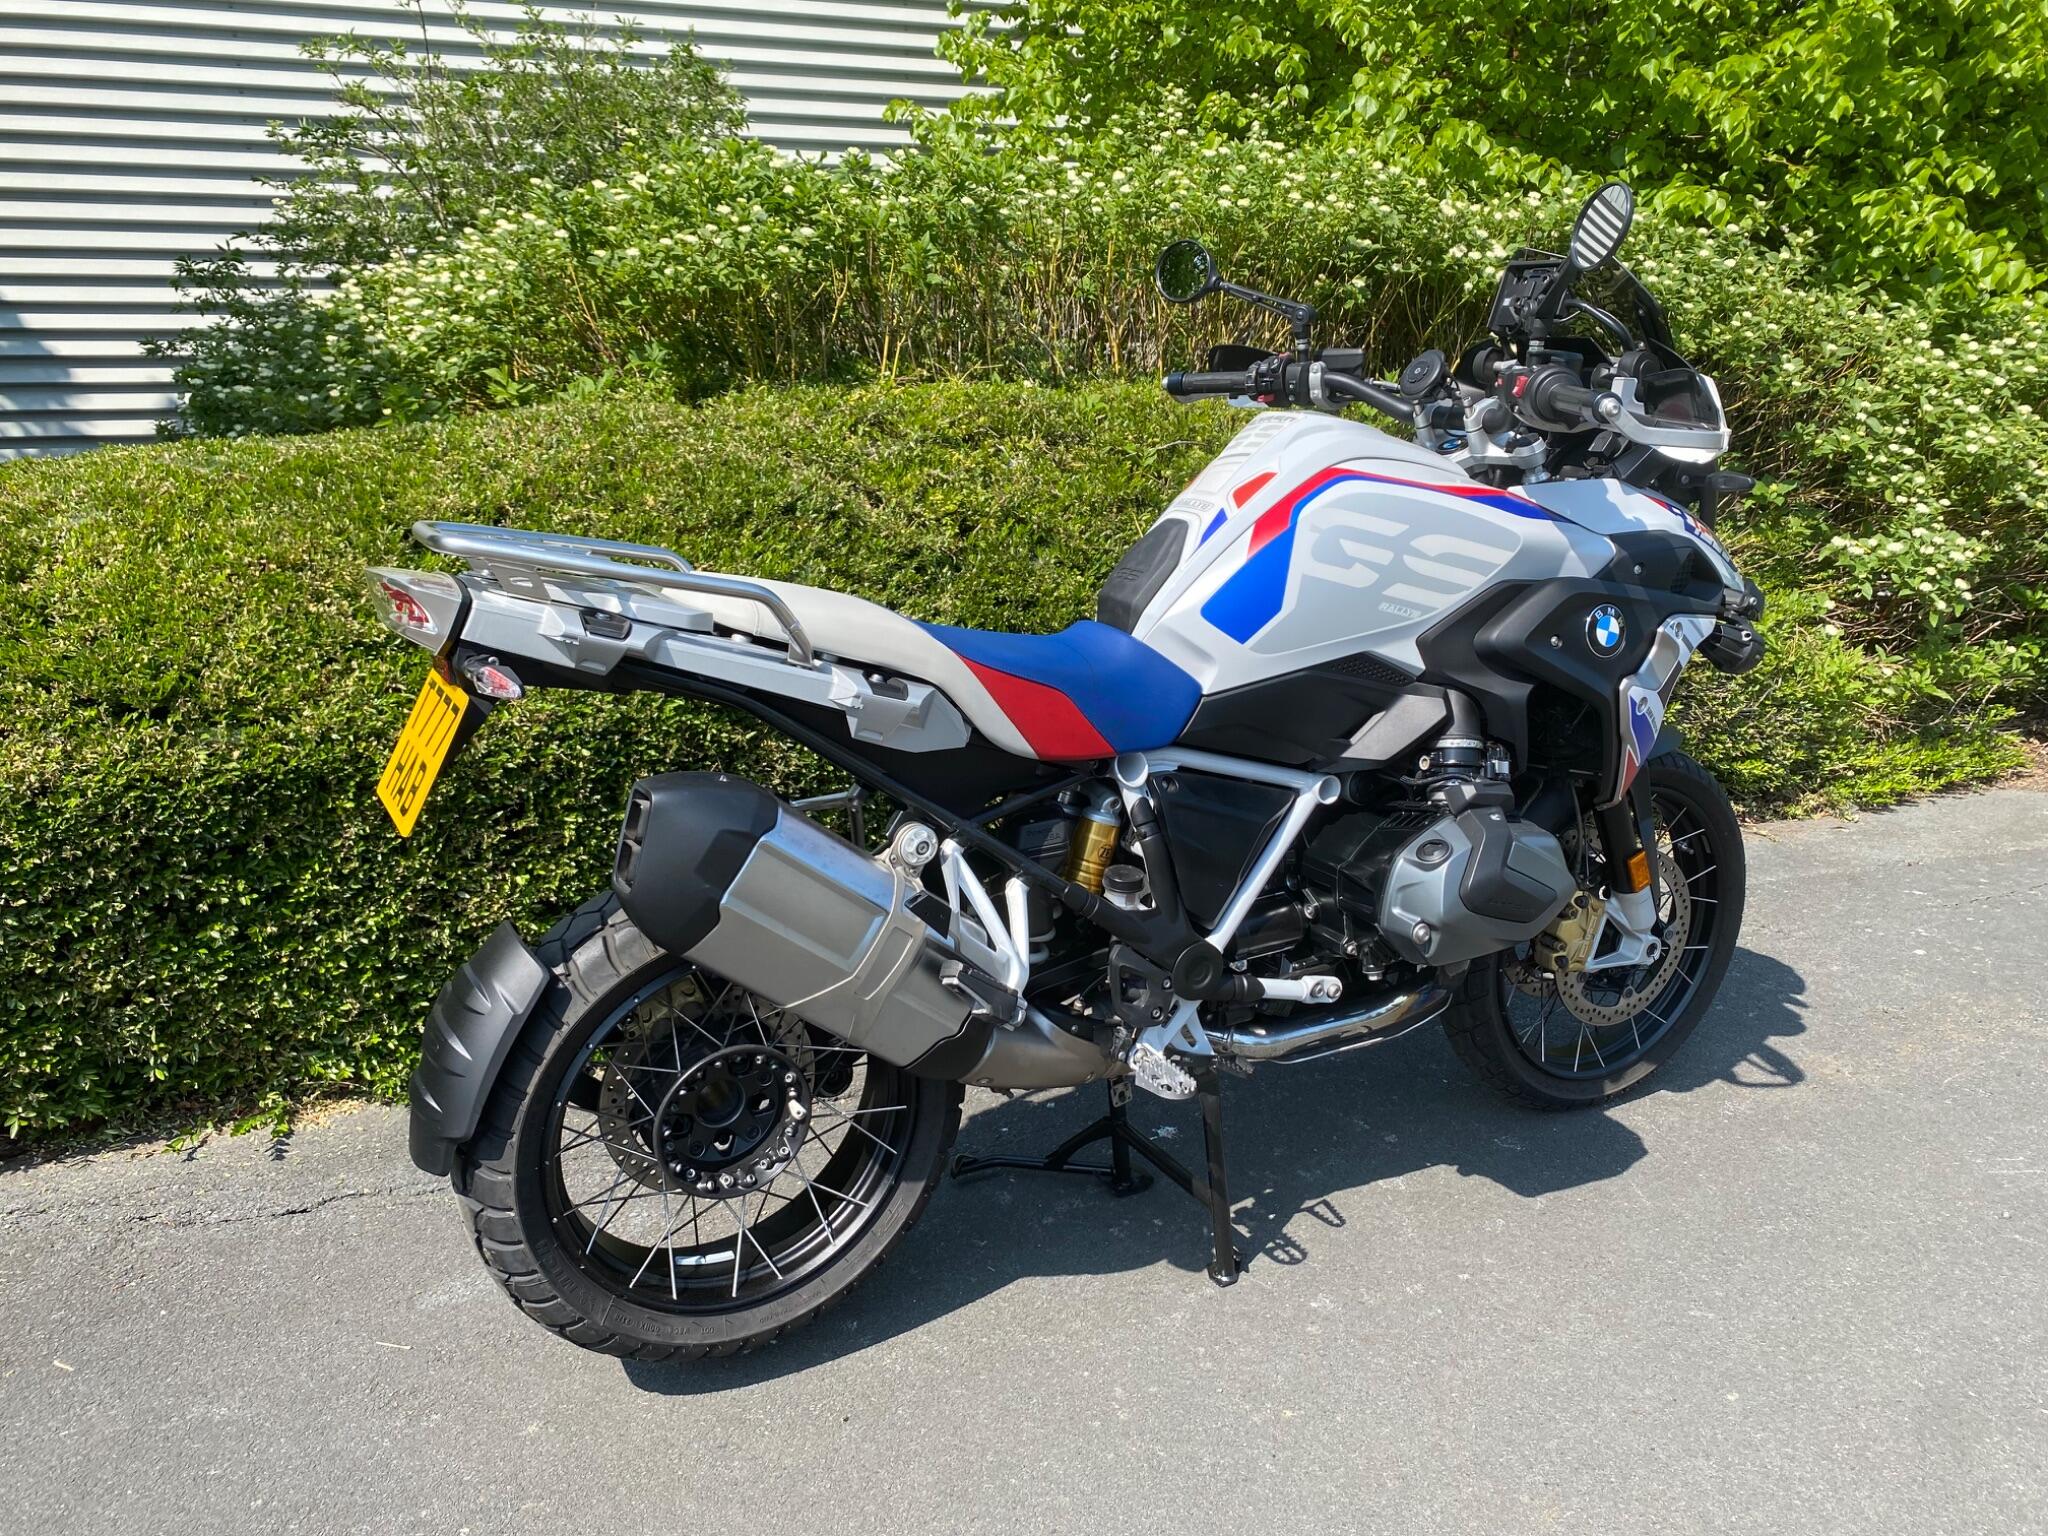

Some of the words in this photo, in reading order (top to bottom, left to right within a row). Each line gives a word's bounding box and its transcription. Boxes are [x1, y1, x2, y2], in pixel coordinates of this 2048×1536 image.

[1302, 504, 1516, 611] GS
[1595, 607, 1624, 627] BMW
[412, 678, 460, 757] T777
[386, 739, 427, 816] HAB
